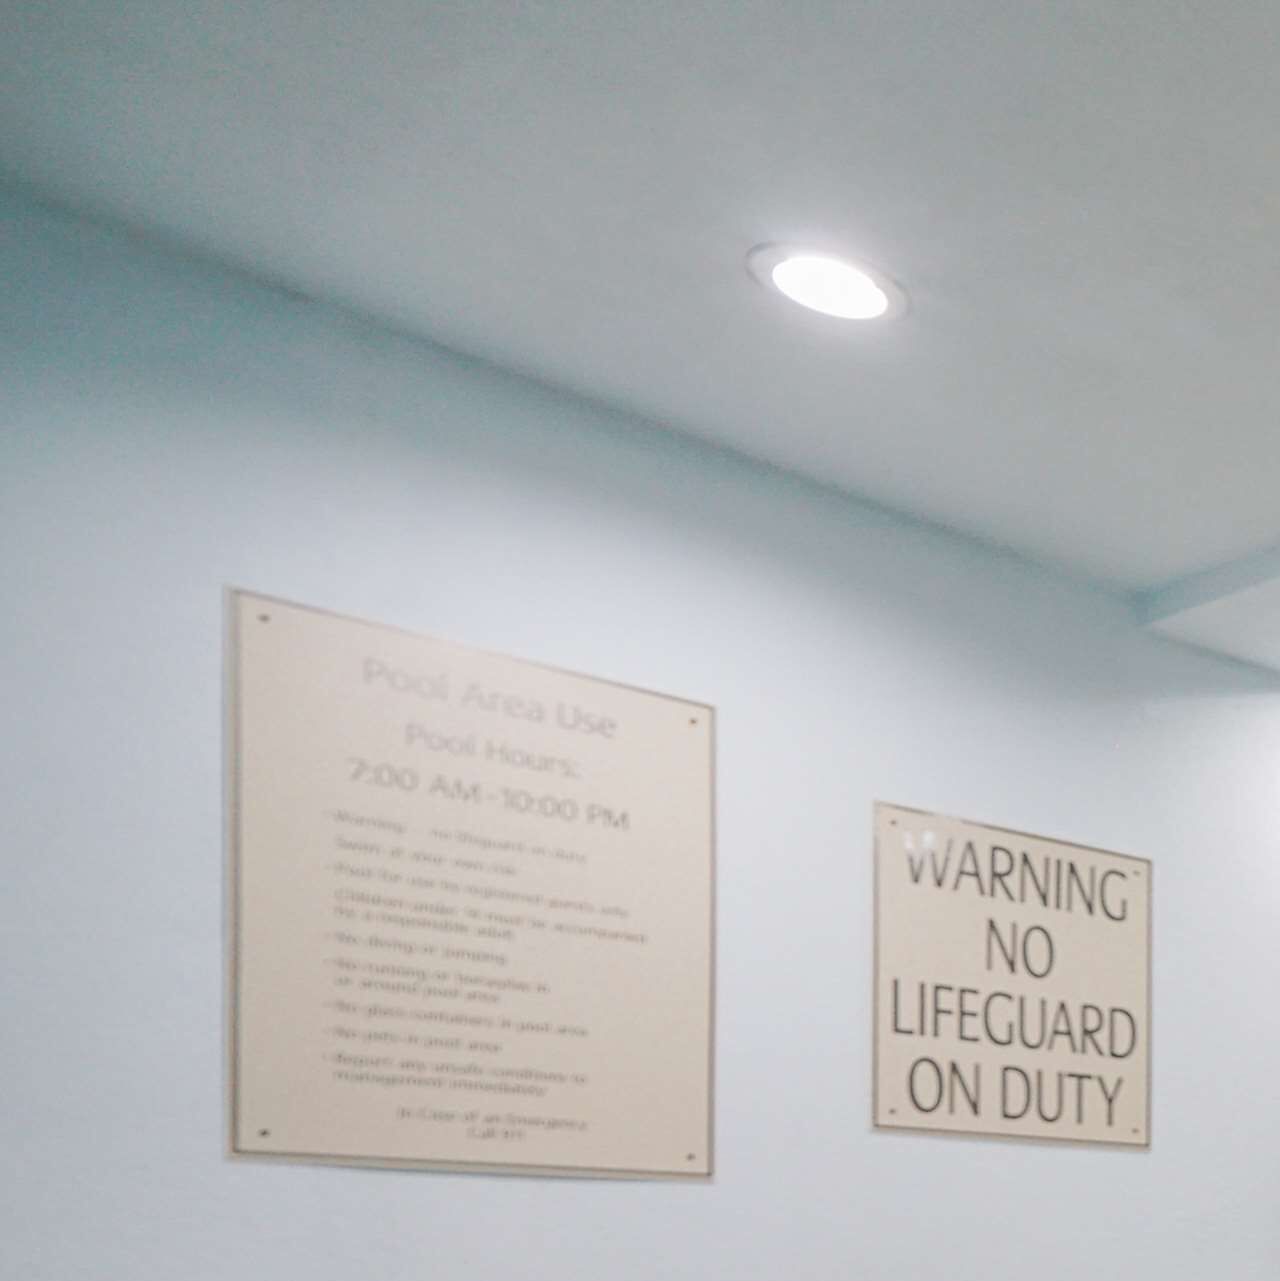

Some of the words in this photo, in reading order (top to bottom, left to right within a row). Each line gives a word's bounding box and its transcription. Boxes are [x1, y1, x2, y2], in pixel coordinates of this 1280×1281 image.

[364, 658, 448, 701] Pool
[461, 682, 545, 724] Area
[556, 700, 618, 740] Use
[405, 721, 477, 757] Pool
[348, 758, 419, 792] 7:00
[585, 802, 631, 834] PM
[905, 835, 1127, 921] WARNING
[986, 917, 1054, 979] NO
[893, 979, 1136, 1058] LIFEGUARD
[908, 1056, 981, 1117] ON
[1001, 1065, 1124, 1127] DUTY
